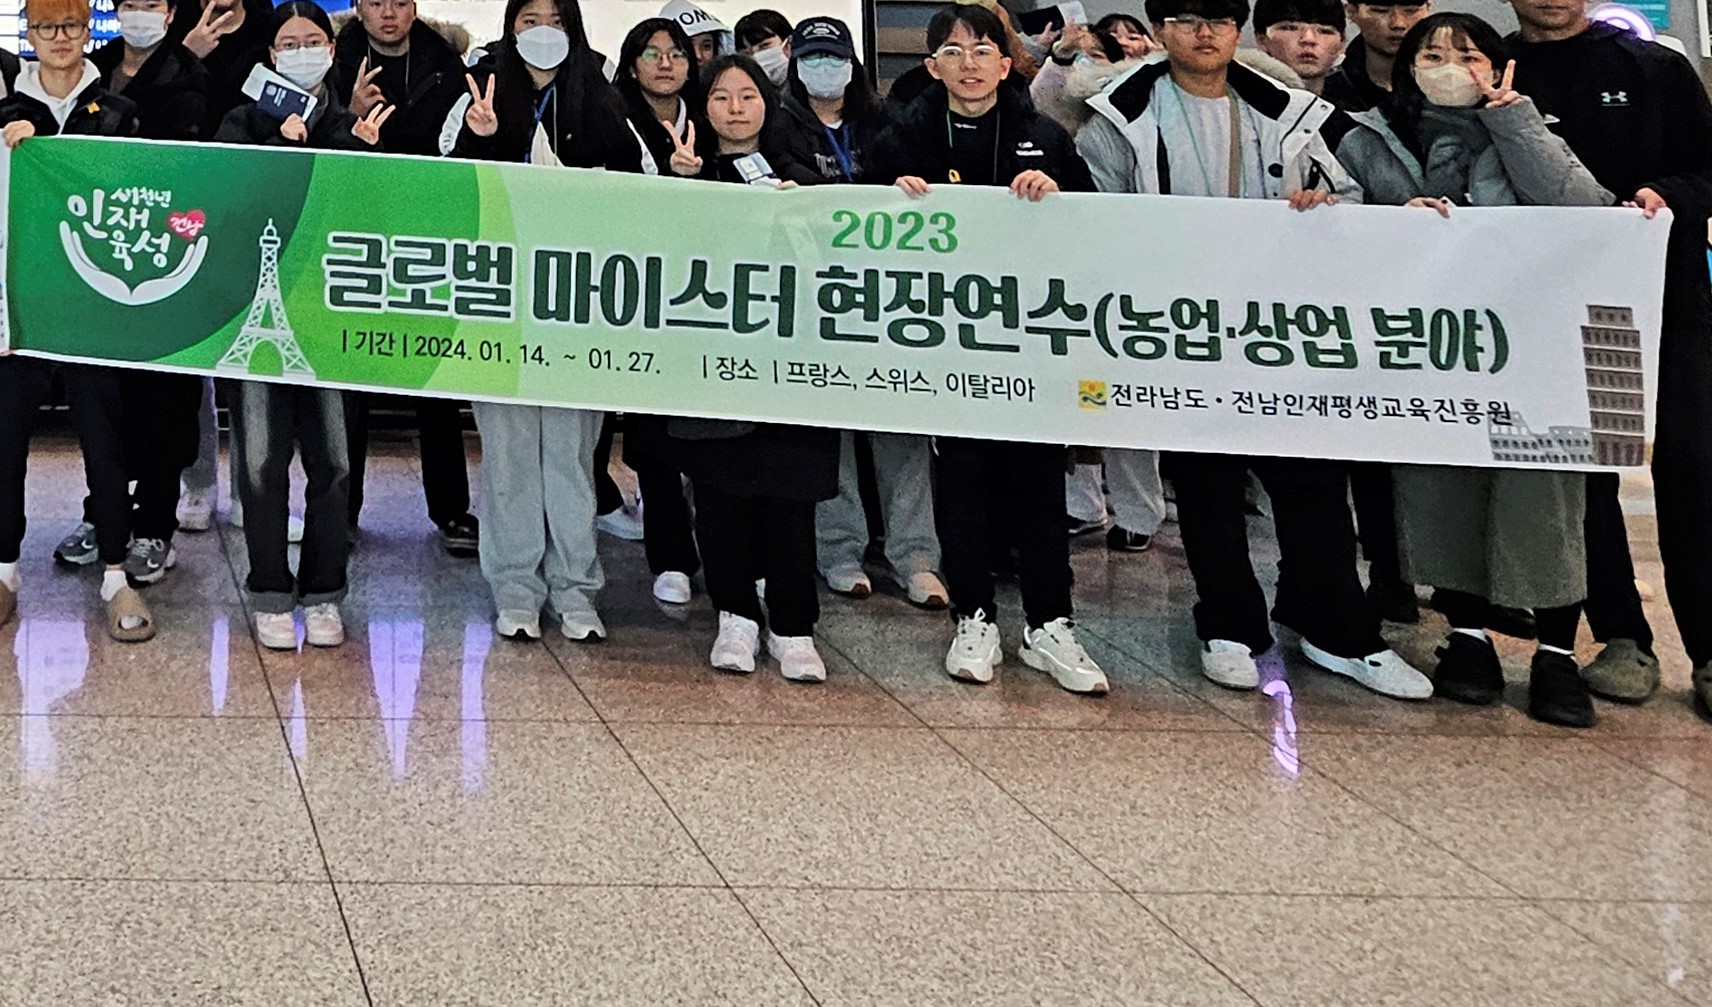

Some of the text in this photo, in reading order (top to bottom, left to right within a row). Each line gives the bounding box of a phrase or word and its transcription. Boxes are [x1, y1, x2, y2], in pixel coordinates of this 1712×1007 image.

[67, 189, 150, 238] 인재
[110, 186, 171, 207] 새천년
[109, 230, 171, 271] 육성
[831, 210, 958, 253] 2023
[325, 233, 514, 320] 글로벌
[531, 248, 796, 338] 마이스터
[1371, 306, 1510, 375] 분야)
[355, 331, 1035, 403] 기간 2024. 01. 14. 01. 27. 장소 프랑스, 스위스, 이탈리아
[1111, 383, 1514, 427] 전라남도 전남인재평생교육진흥원
